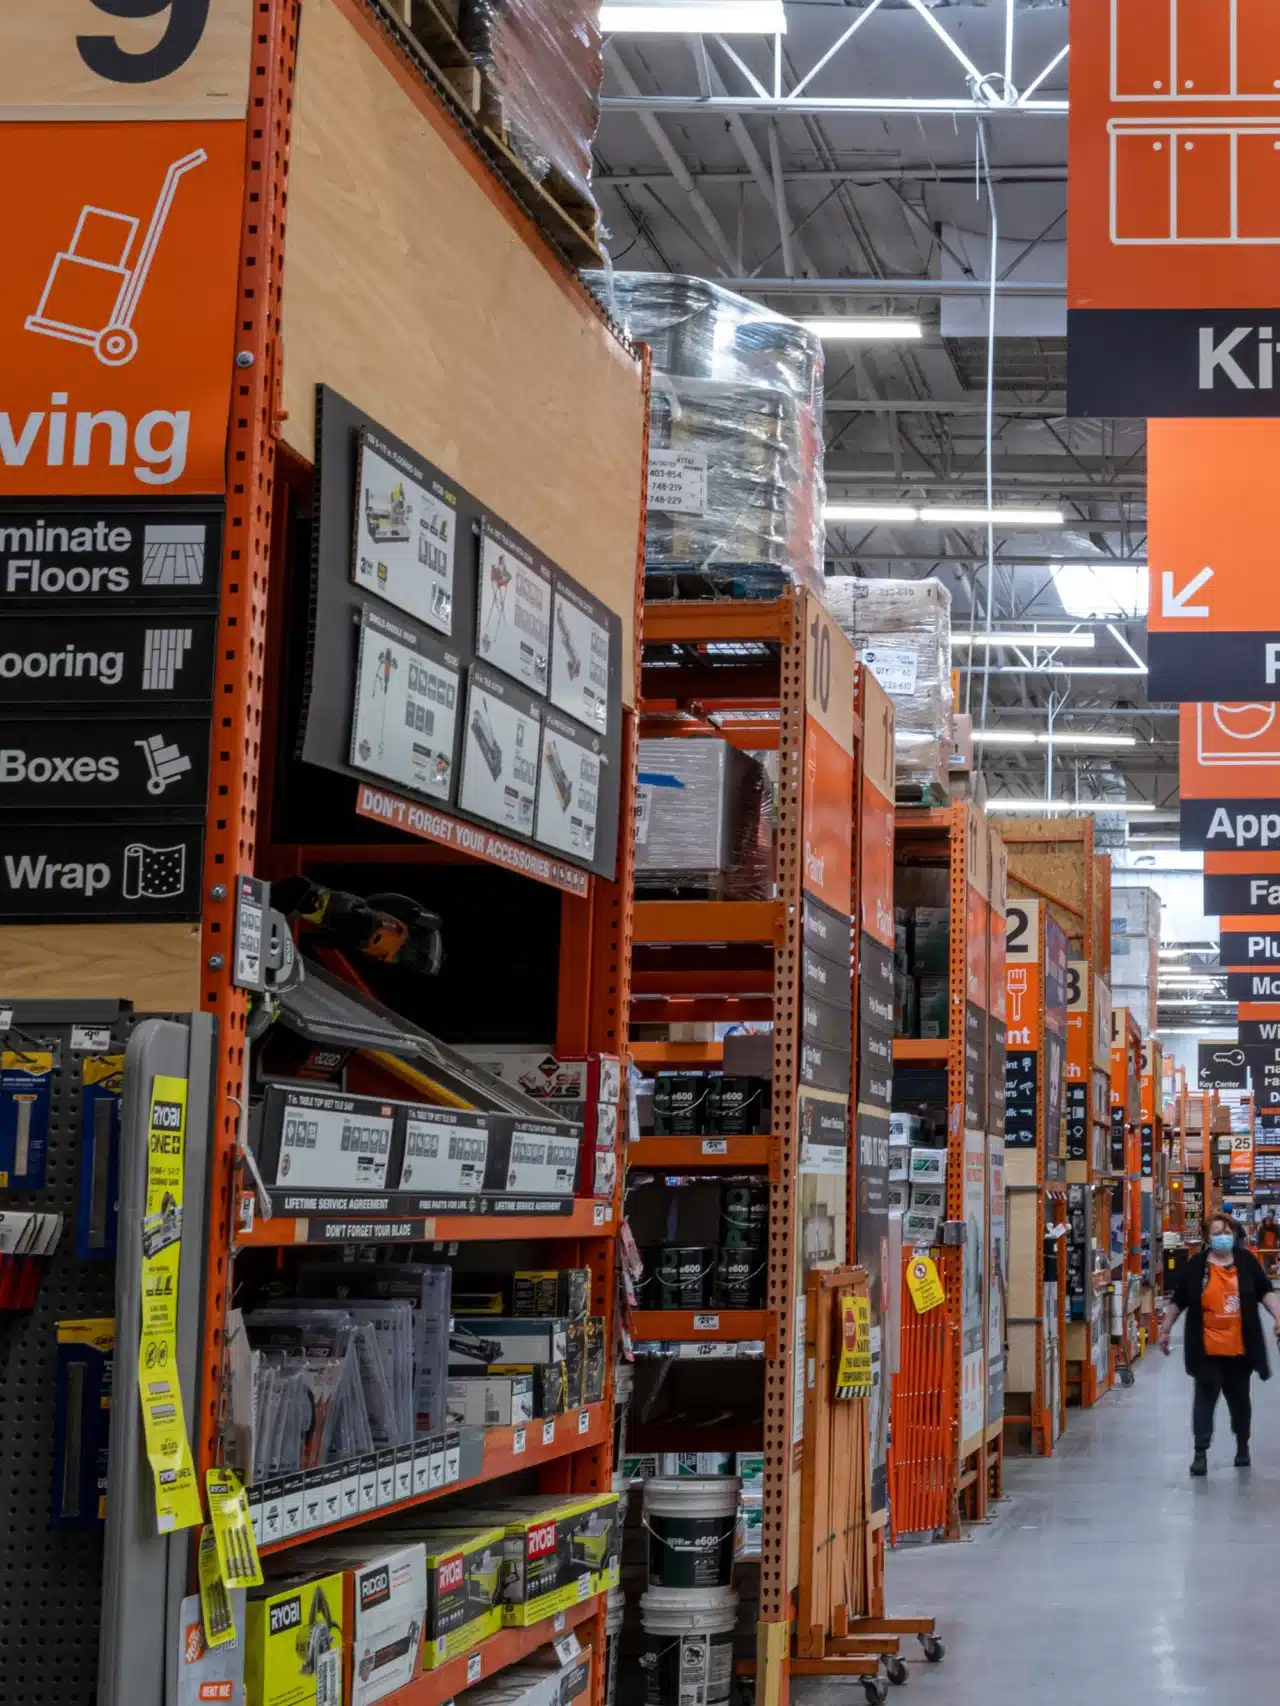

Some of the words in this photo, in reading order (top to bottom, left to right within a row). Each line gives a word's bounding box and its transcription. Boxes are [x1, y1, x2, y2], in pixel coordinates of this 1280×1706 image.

[0, 391, 191, 485] ving
[0, 519, 132, 553] minate
[6, 559, 130, 593] Floors
[0, 644, 124, 685] ooring
[0, 749, 120, 783] Boxes
[362, 788, 406, 824] DON'T
[408, 806, 453, 841] FORGET
[455, 824, 486, 853] YOUR
[486, 838, 550, 879] ACCESSORIES
[4, 854, 111, 896] Wrap
[671, 1091, 693, 1101] e600
[721, 1091, 743, 1101] e600
[1199, 1080, 1214, 1089] Key
[1218, 1080, 1240, 1089] Center
[153, 1105, 181, 1127] RYOBI
[1234, 1137, 1251, 1150] 25
[284, 1198, 317, 1210] LIFETIME
[318, 1198, 349, 1210] SERVICE
[349, 1198, 389, 1210] AGREEMENT
[494, 1201, 513, 1211] LIFETIME
[532, 1202, 561, 1211] AGREEMENT
[325, 1224, 347, 1237] DON'T
[347, 1224, 374, 1237] FORGET
[374, 1224, 392, 1237] YOUR
[391, 1223, 412, 1236] BLADE
[679, 1263, 701, 1274] e600
[728, 1263, 750, 1274] e600
[528, 1525, 557, 1555] RYOBI
[694, 1535, 719, 1545] e600
[361, 1572, 388, 1597] RIDGID
[439, 1558, 464, 1589] RYOBI
[270, 1600, 300, 1631] RYOBI
